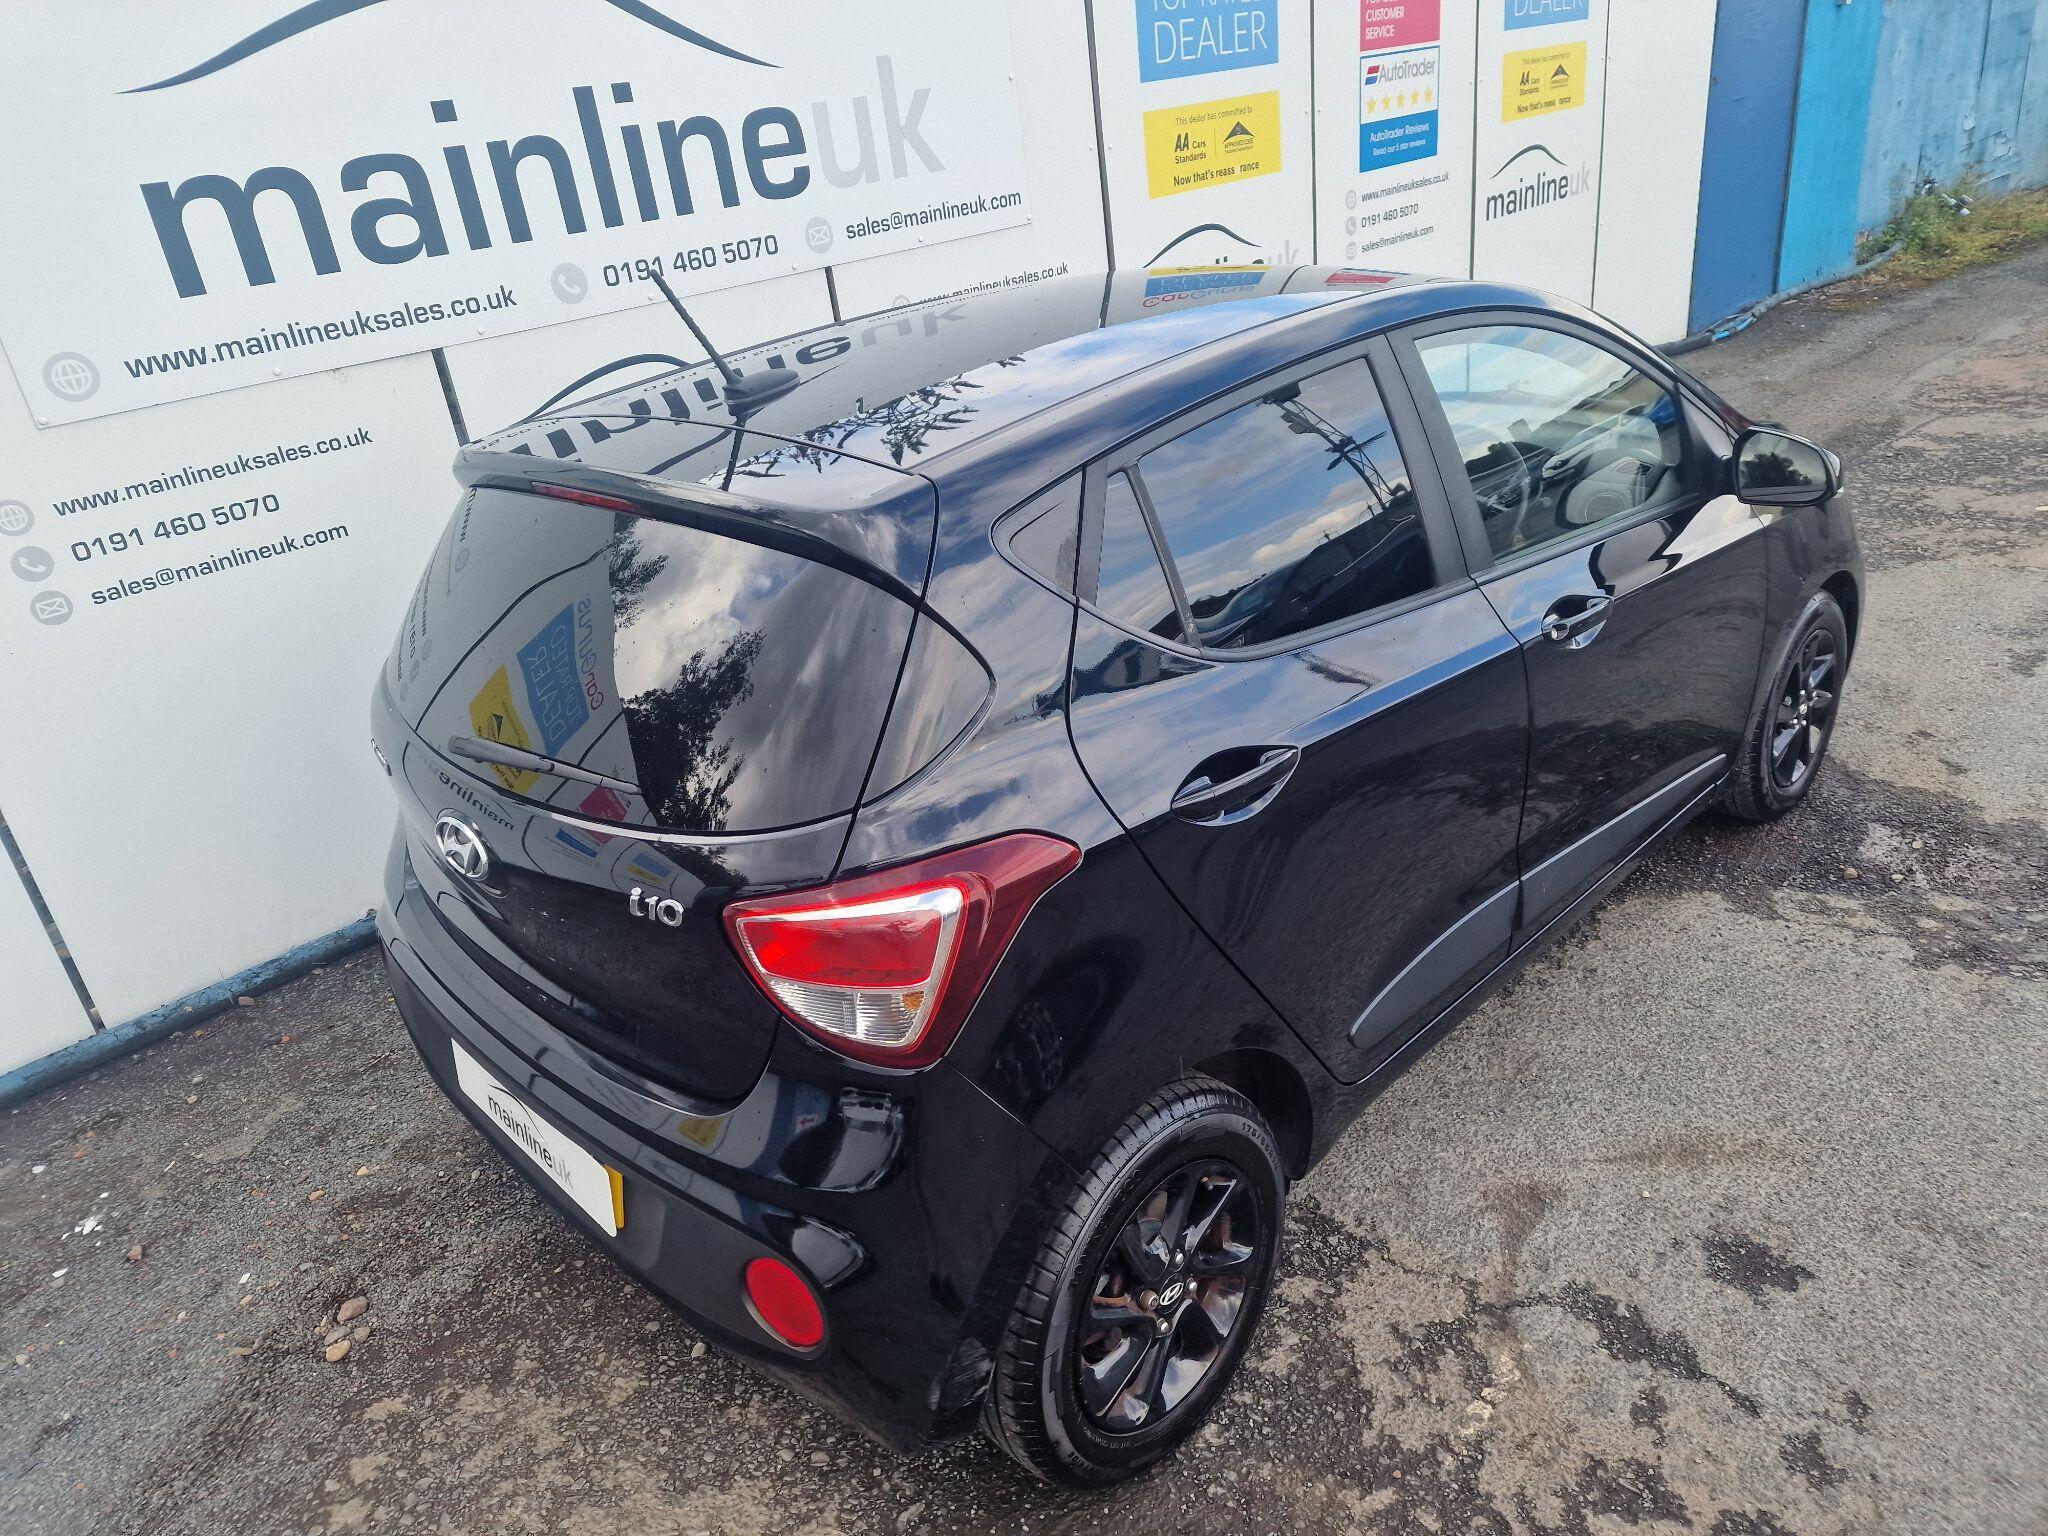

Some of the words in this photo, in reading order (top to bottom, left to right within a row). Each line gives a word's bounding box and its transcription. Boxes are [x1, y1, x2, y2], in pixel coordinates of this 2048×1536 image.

[1366, 6, 1405, 22] CUSTOMER
[1153, 10, 1268, 65] DEALER
[1365, 24, 1396, 40] SERVICE
[1378, 58, 1437, 84] AutoTrader
[1174, 132, 1190, 153] AA
[1192, 139, 1207, 149] Cars
[1174, 150, 1208, 165] Standards
[1173, 175, 1192, 187] Now
[1192, 168, 1215, 183] that's
[1361, 171, 1450, 202] www.mainlineuksales.co.uk
[845, 191, 1022, 240] sales@mainlineuk.com
[1361, 212, 1381, 228] 0191
[1382, 208, 1398, 222] 460
[1399, 203, 1419, 218] 5070
[1361, 224, 1434, 253] sales@mainlineuk.com
[602, 255, 665, 287] 0191
[672, 246, 717, 273] 460
[721, 234, 779, 264] 5070
[124, 284, 518, 378] www.mainlineuksales.co.uk
[52, 427, 374, 517] www.mainlineuksales.co.uk
[70, 527, 145, 562] 0191
[153, 512, 207, 541] 460
[211, 494, 281, 526] 5070
[90, 523, 350, 605] sales@mainlineuk.com
[628, 886, 685, 928] i10
